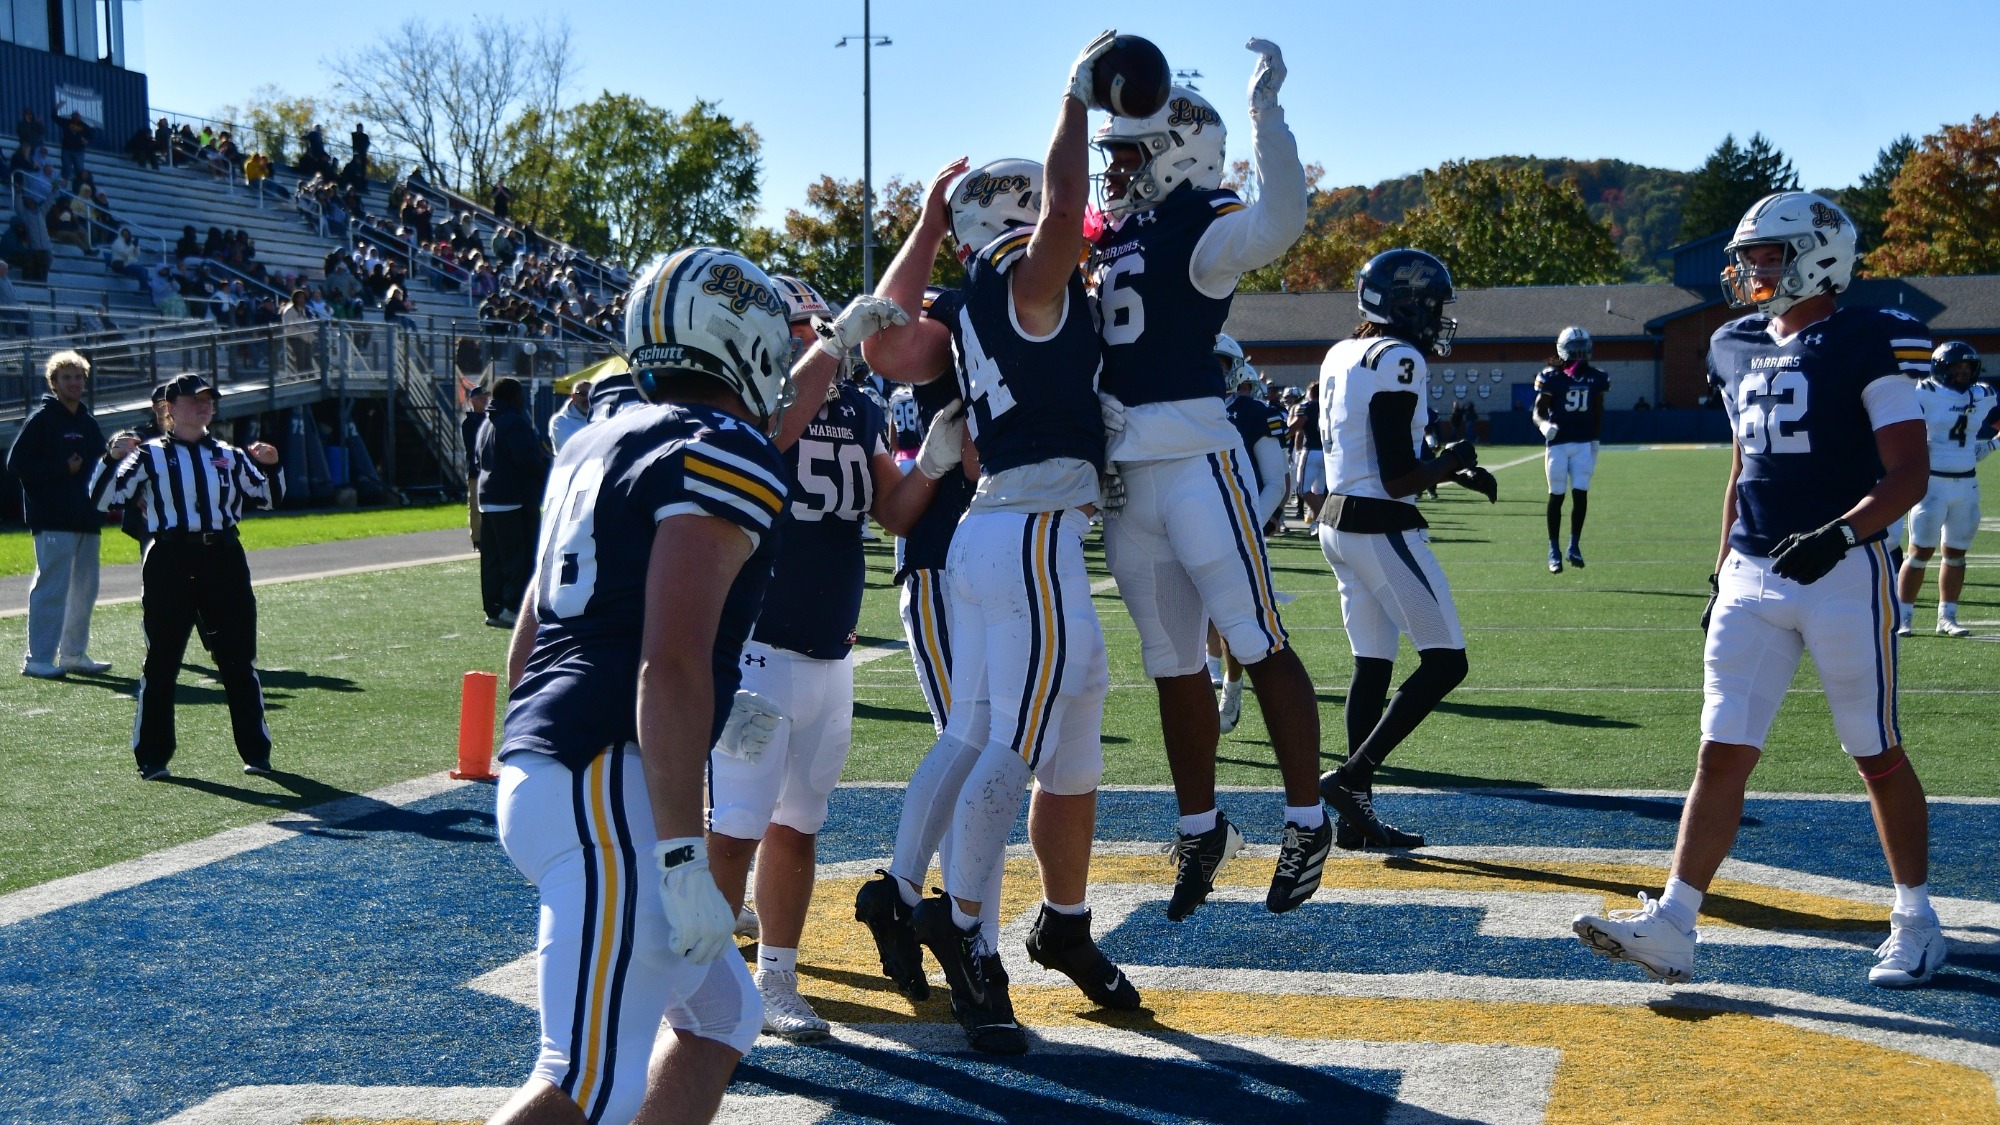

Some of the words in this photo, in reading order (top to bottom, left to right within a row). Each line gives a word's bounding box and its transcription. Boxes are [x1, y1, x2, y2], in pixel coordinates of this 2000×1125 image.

[961, 172, 1031, 208] Lyco
[1096, 240, 1139, 264] ARRIORS
[1394, 260, 1438, 288] JC
[702, 264, 782, 317] Lyco
[1101, 253, 1145, 346] 6
[638, 345, 684, 362] schutt
[1751, 356, 1800, 370] WARRIORS
[1397, 358, 1415, 384] 3
[1565, 390, 1589, 412] 91
[1738, 372, 1811, 454] 62
[893, 402, 917, 432] 88
[1949, 414, 1968, 447] 4
[808, 424, 854, 440] WARRIORS
[220, 474, 230, 487] L
[790, 438, 873, 522] 50
